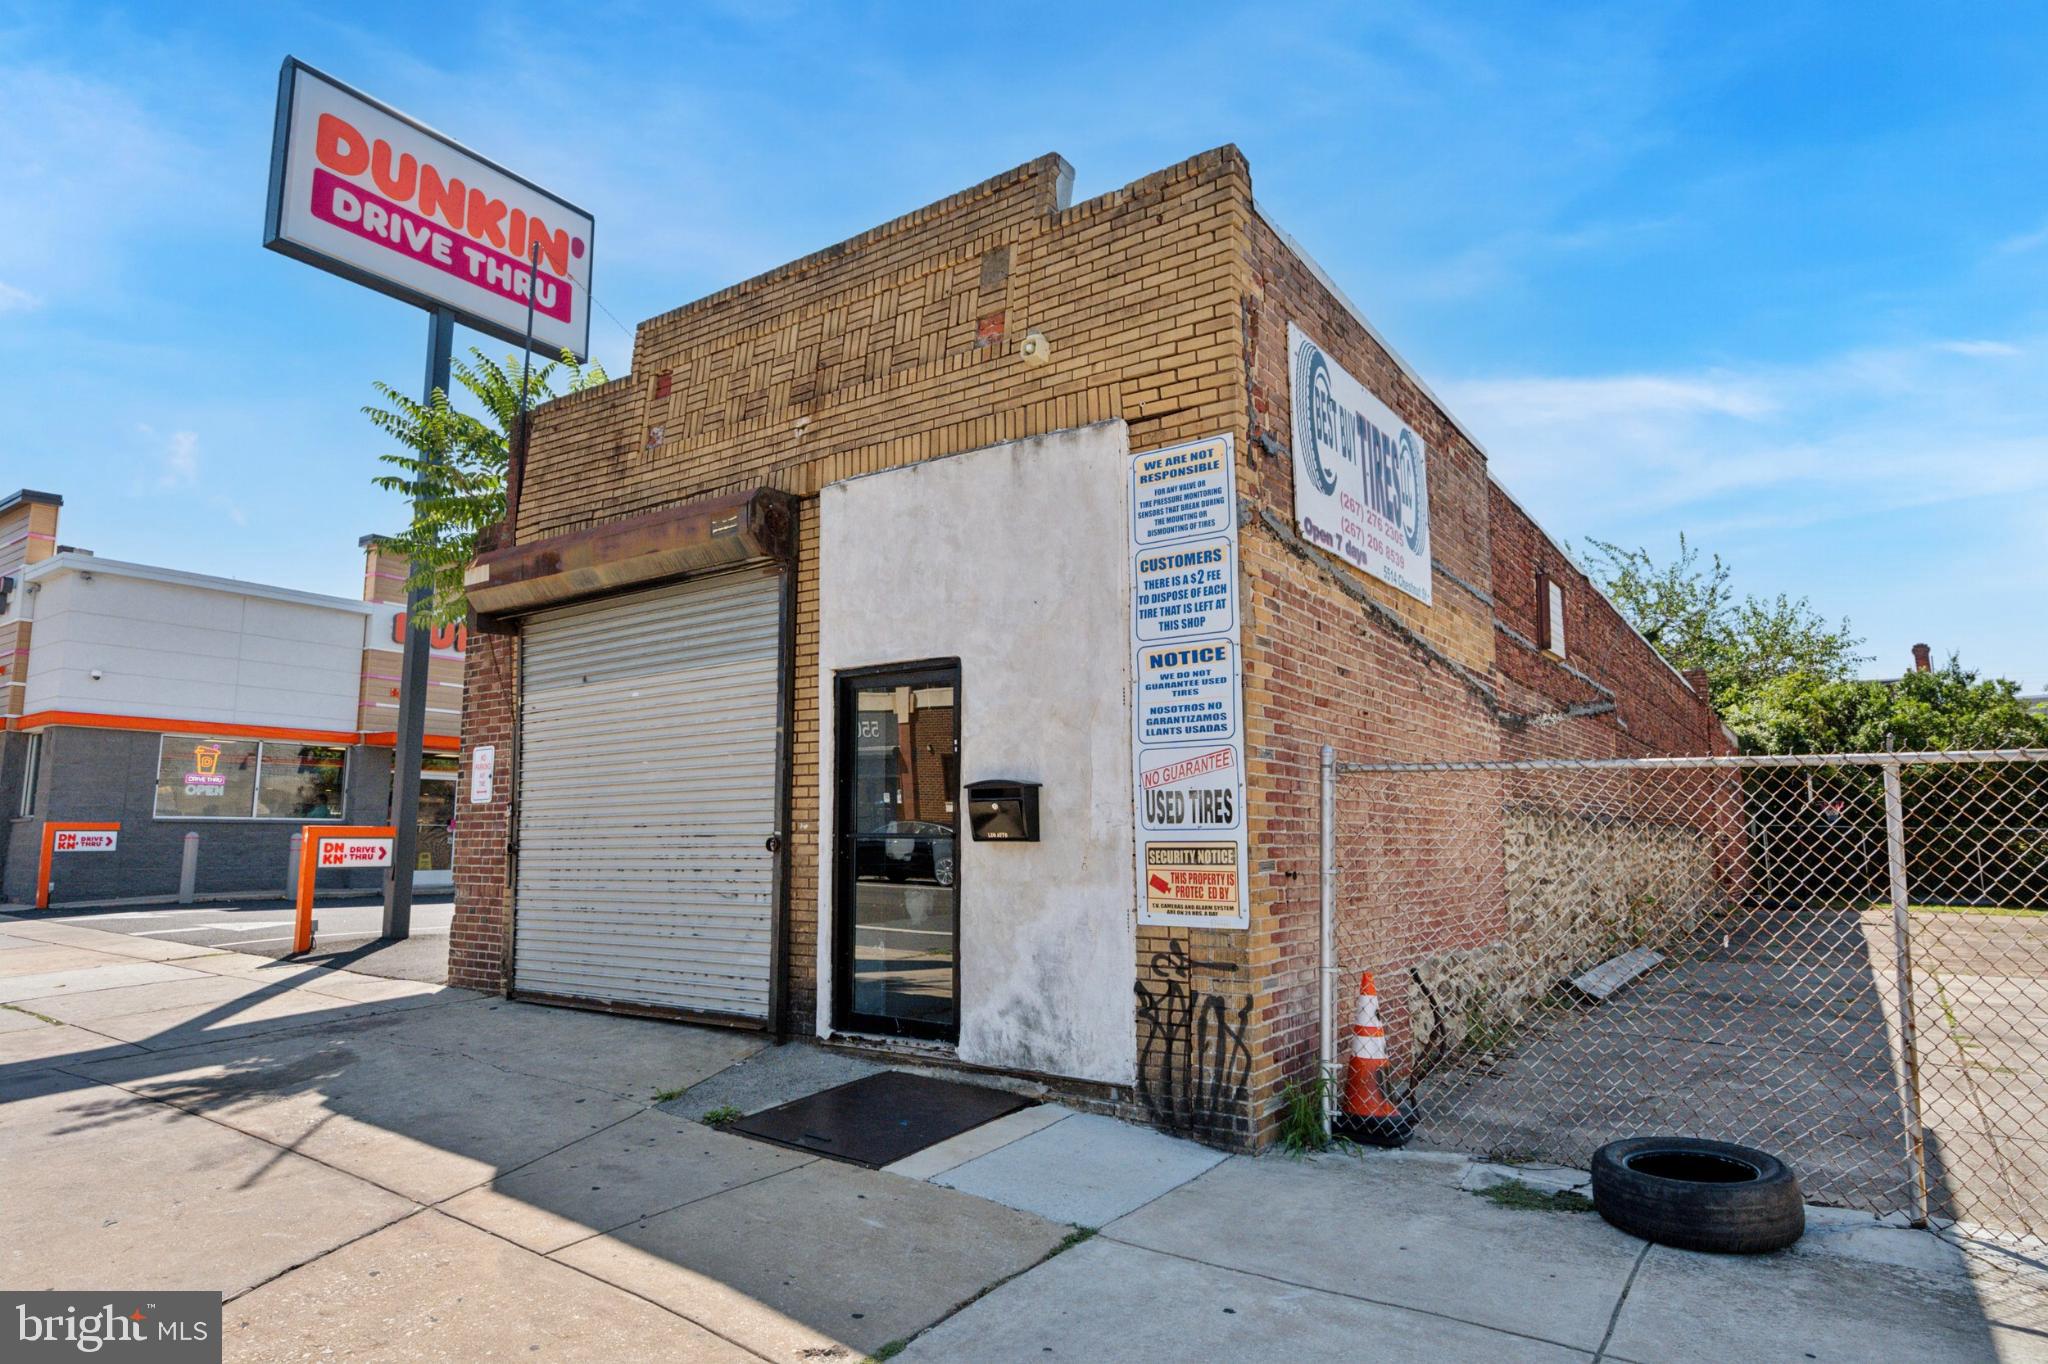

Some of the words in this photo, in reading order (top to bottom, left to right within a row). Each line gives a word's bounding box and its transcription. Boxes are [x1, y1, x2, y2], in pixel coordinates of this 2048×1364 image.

[333, 187, 453, 265] DRIVE
[463, 246, 557, 309] THRU
[1143, 459, 1163, 471] WE
[1165, 454, 1187, 467] ARE
[1190, 448, 1214, 461] NOT
[1314, 385, 1338, 453] BEST
[1339, 405, 1357, 466] BUY
[1355, 410, 1402, 529] TIRES
[1140, 460, 1220, 484] RESPONSIBLE
[1154, 488, 1166, 496] FOR
[1166, 485, 1178, 494] ANY
[1179, 482, 1196, 491] VALVE
[1197, 480, 1206, 488] OR
[1140, 501, 1152, 509] TIRE
[1153, 494, 1182, 506] PRESSURE
[1183, 487, 1222, 499] MONITORING
[1137, 509, 1164, 519] SENSORS
[1166, 506, 1179, 514] THAT
[1181, 501, 1200, 511] BREAK
[1201, 497, 1225, 508] DURING
[1340, 491, 1364, 523] (267)
[1366, 509, 1383, 532] 276
[1154, 518, 1165, 526] THE
[1166, 512, 1198, 524] MOUNTING
[1199, 510, 1208, 518] OR
[1147, 524, 1189, 537] DISMOUNTING
[1189, 522, 1197, 530] OF
[1198, 519, 1216, 528] TIRES
[1341, 516, 1365, 547] (267)
[1303, 516, 1333, 547] Open
[1335, 533, 1343, 551] 7
[1345, 540, 1368, 565] days
[1140, 548, 1222, 573] CUSTOMERS
[1144, 577, 1170, 590] THERE
[1172, 576, 1181, 586] IS
[1182, 574, 1189, 585] A
[1190, 569, 1205, 584] $2
[1207, 570, 1221, 581] FEE
[1139, 594, 1149, 605] TO
[1151, 589, 1189, 603] DISPOSE
[1190, 587, 1202, 598] OF
[1203, 584, 1227, 596] EACH
[1139, 608, 1158, 619] TIRE
[1159, 604, 1181, 617] THAT
[1183, 603, 1192, 614] IS
[1194, 600, 1214, 612] LEFT
[1215, 598, 1226, 610] AT
[1159, 620, 1179, 632] THIS
[1181, 616, 1206, 629] SHOP
[1149, 646, 1226, 669] NOTICE
[1145, 679, 1199, 690] GUARANTEE
[1202, 677, 1227, 685] USED
[1177, 671, 1190, 679] DO
[1192, 669, 1211, 677] NOT
[1172, 688, 1199, 697] TIRES
[1150, 703, 1205, 715] NOSOTROS
[1208, 701, 1223, 710] NO
[1146, 712, 1227, 726] GARANTIZAMOS
[1146, 726, 1182, 736] LLANTS
[1185, 723, 1228, 734] USADAS
[1144, 771, 1160, 787] NO
[1162, 751, 1230, 781] GUARANTEE
[185, 784, 224, 796] OPEN
[1146, 790, 1184, 824] USED
[1189, 788, 1233, 824] TIRES
[59, 834, 77, 842] DN
[323, 842, 345, 853] DN
[1149, 849, 1196, 864] SECURITY
[1197, 849, 1234, 864] NOTICE
[1170, 872, 1187, 884] THIS
[1188, 872, 1225, 886] PROPERTY
[1227, 874, 1235, 886] IS
[1219, 887, 1229, 899] BY
